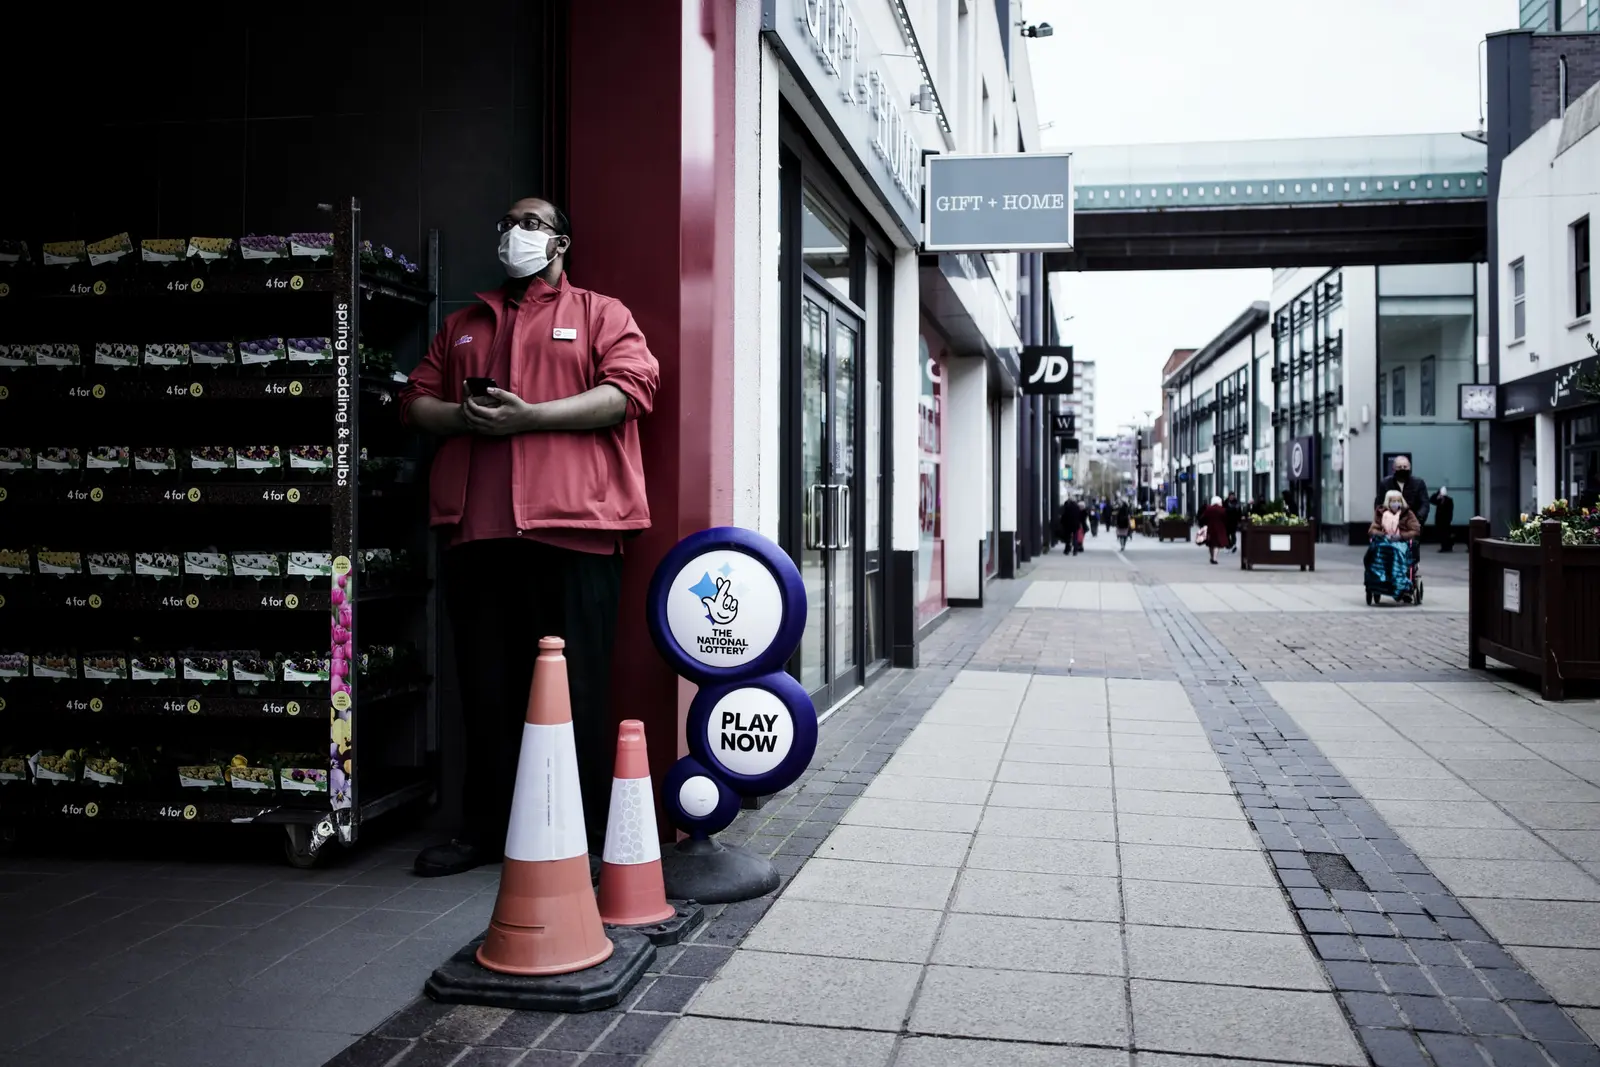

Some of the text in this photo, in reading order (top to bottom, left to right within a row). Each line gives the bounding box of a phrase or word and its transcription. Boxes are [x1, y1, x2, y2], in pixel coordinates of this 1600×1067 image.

[936, 194, 1064, 212] GIFT + HOME
[70, 284, 76, 293] 4
[77, 283, 91, 293] for
[167, 281, 173, 291] 4
[175, 280, 189, 290] for
[265, 279, 272, 288] 4
[274, 278, 288, 288] for
[1029, 355, 1069, 384] JD
[69, 388, 76, 396] 4
[77, 387, 91, 396] for
[166, 386, 173, 395] 4
[174, 385, 188, 395] for
[265, 384, 272, 393] 4
[273, 383, 287, 393] for
[335, 303, 350, 486] spring bedding & bulbs
[1057, 417, 1071, 429] W
[67, 490, 74, 499] 4
[75, 490, 88, 500] for
[164, 491, 170, 500] 4
[172, 490, 186, 500] for
[262, 491, 269, 500] 4
[270, 490, 285, 500] for
[65, 597, 72, 606] 4
[73, 597, 87, 606] for
[162, 597, 169, 606] 4
[170, 596, 184, 606] for
[261, 597, 268, 606] 4
[269, 596, 283, 606] for
[712, 628, 733, 638] THE
[697, 635, 749, 647] NATIONAL
[699, 644, 747, 655] LOTTERY
[66, 700, 73, 709] 4
[74, 700, 88, 709] for
[163, 702, 170, 711] 4
[171, 701, 185, 711] for
[262, 704, 269, 713] 4
[270, 703, 284, 713] for
[721, 711, 778, 733] PLAY
[721, 733, 778, 753] NOW
[62, 804, 68, 814] 4
[69, 804, 83, 814] for
[159, 807, 166, 816] 4
[167, 806, 181, 817] for
